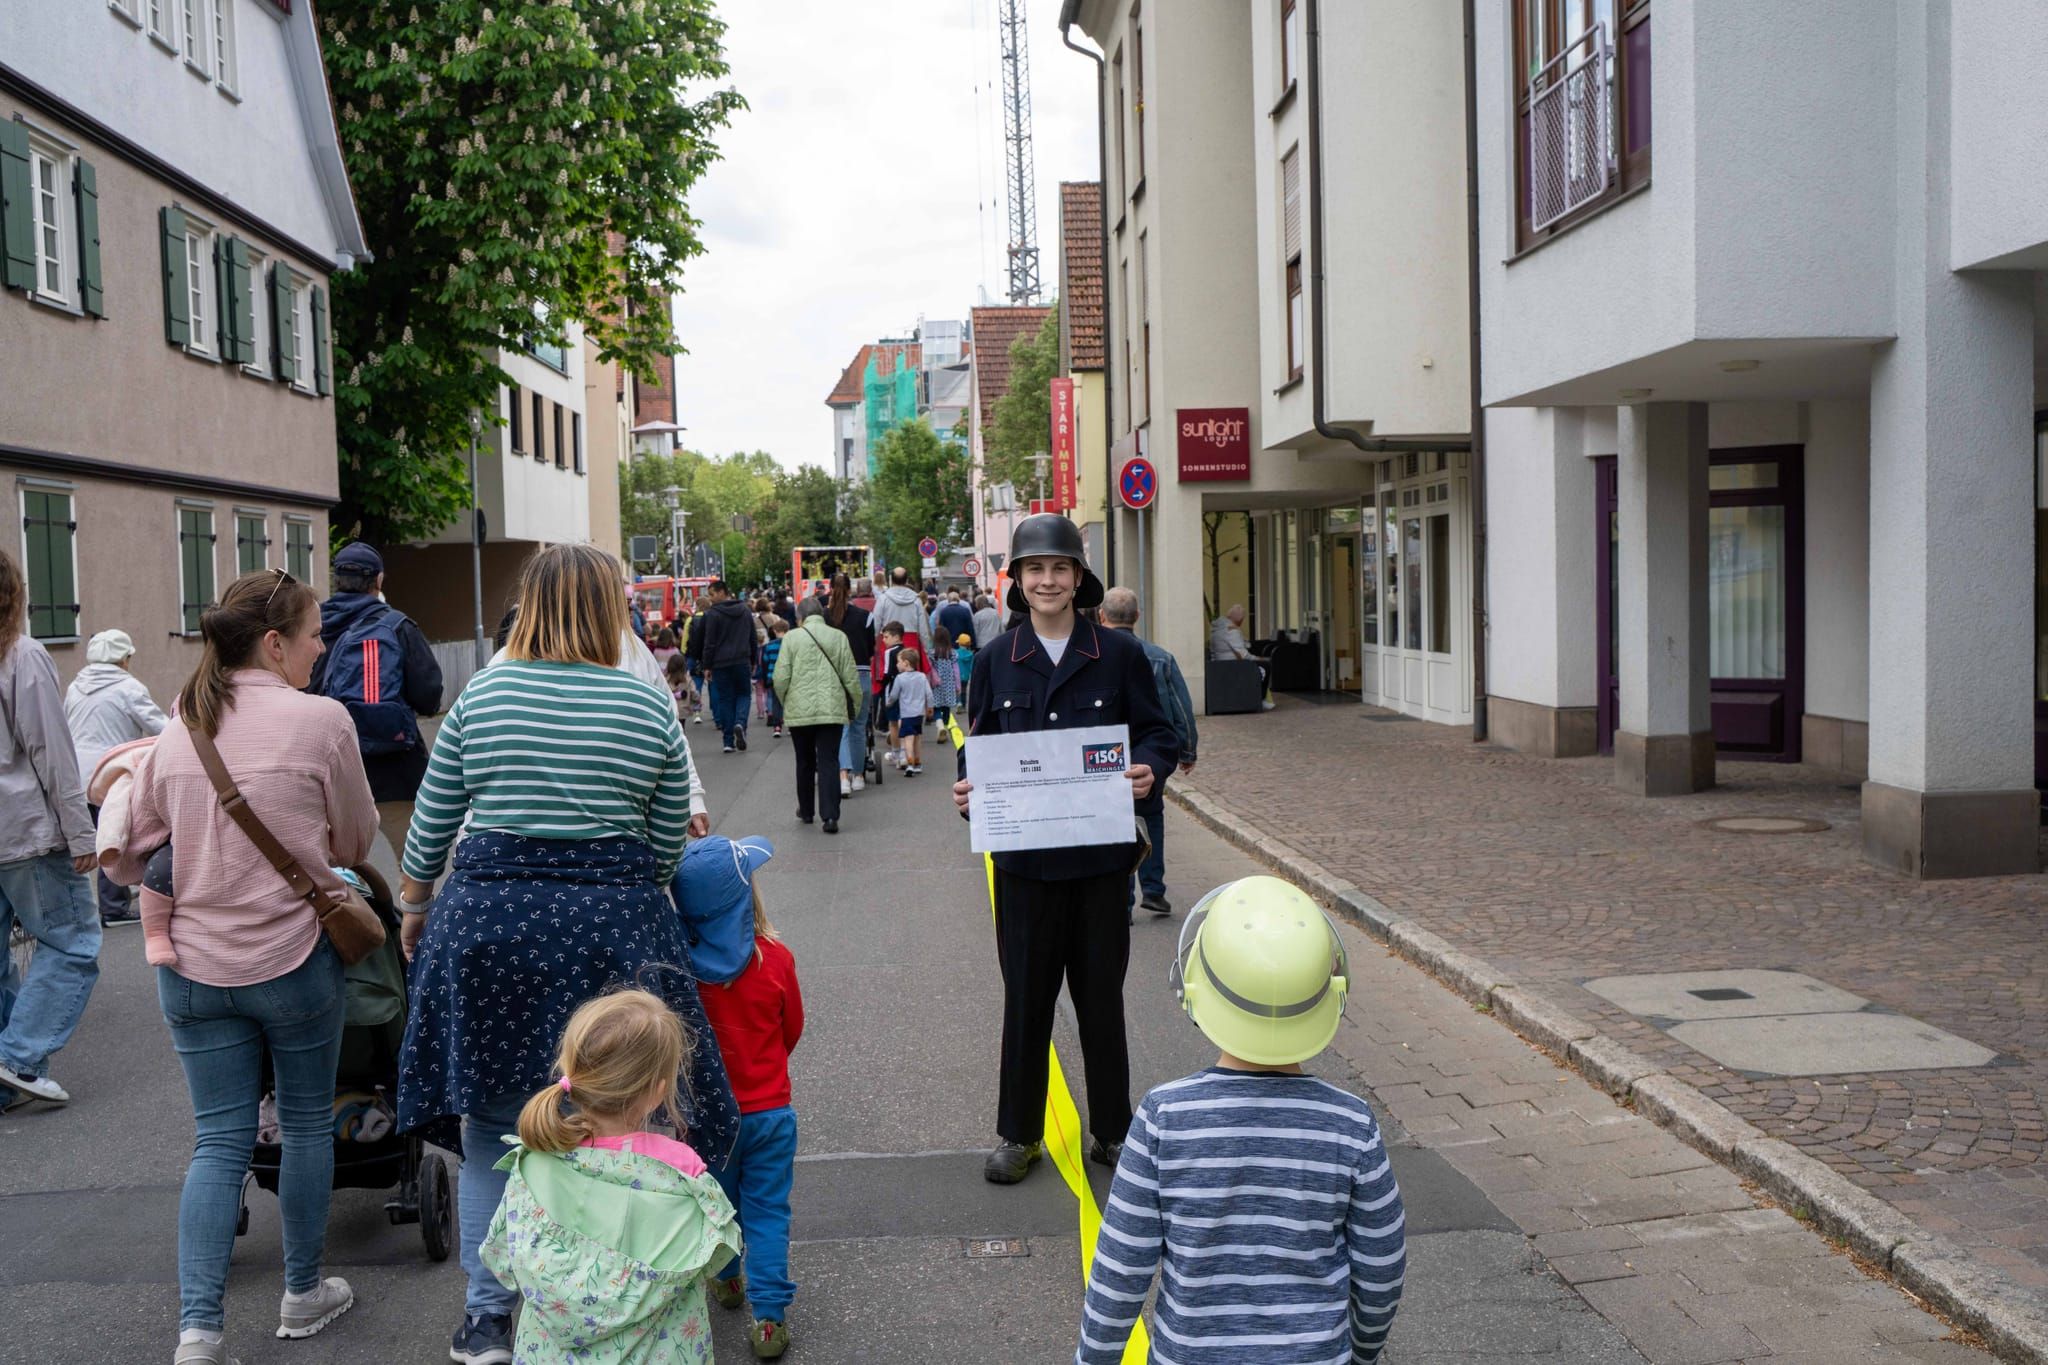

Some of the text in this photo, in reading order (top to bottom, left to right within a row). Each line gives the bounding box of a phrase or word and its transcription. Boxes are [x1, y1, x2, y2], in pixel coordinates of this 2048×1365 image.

[1058, 390, 1068, 435] STAR
[1182, 418, 1244, 447] sunlight
[1058, 438, 1070, 506] IMBISS
[1182, 463, 1247, 472] SONNENSTUDIO
[967, 563, 977, 572] 30
